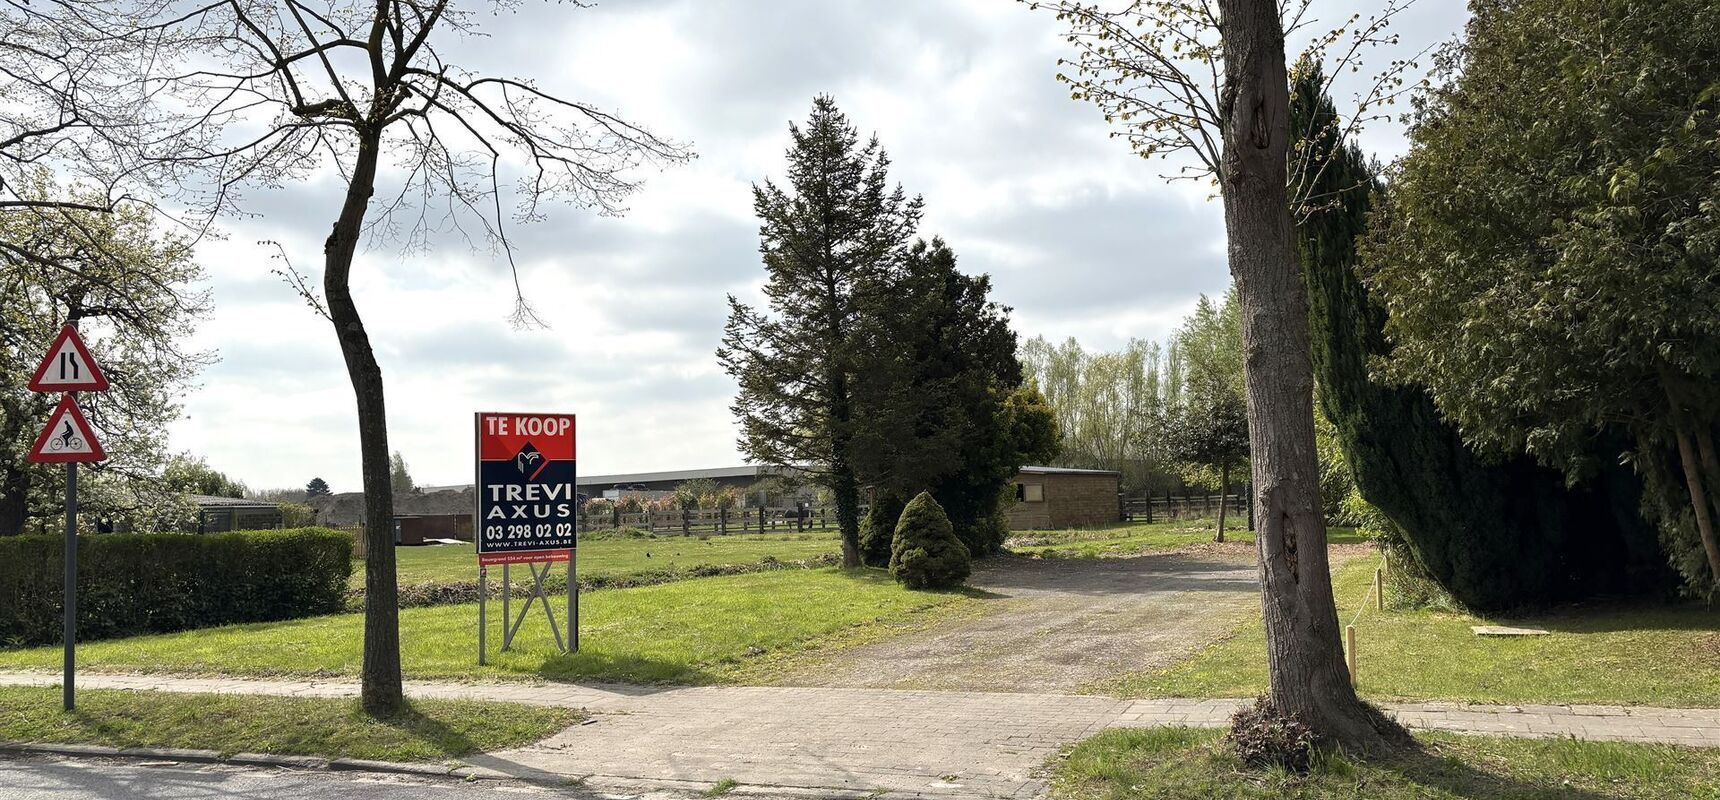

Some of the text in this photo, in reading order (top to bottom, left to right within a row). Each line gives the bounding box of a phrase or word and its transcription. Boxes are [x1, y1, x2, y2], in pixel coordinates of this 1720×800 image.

[486, 417, 570, 436] TE KOOP
[487, 484, 571, 501] TREVI
[486, 504, 570, 519] AXUS
[486, 523, 572, 540] 03 298 02 02
[486, 539, 572, 548] WWW.TREVI-AXUS.BE
